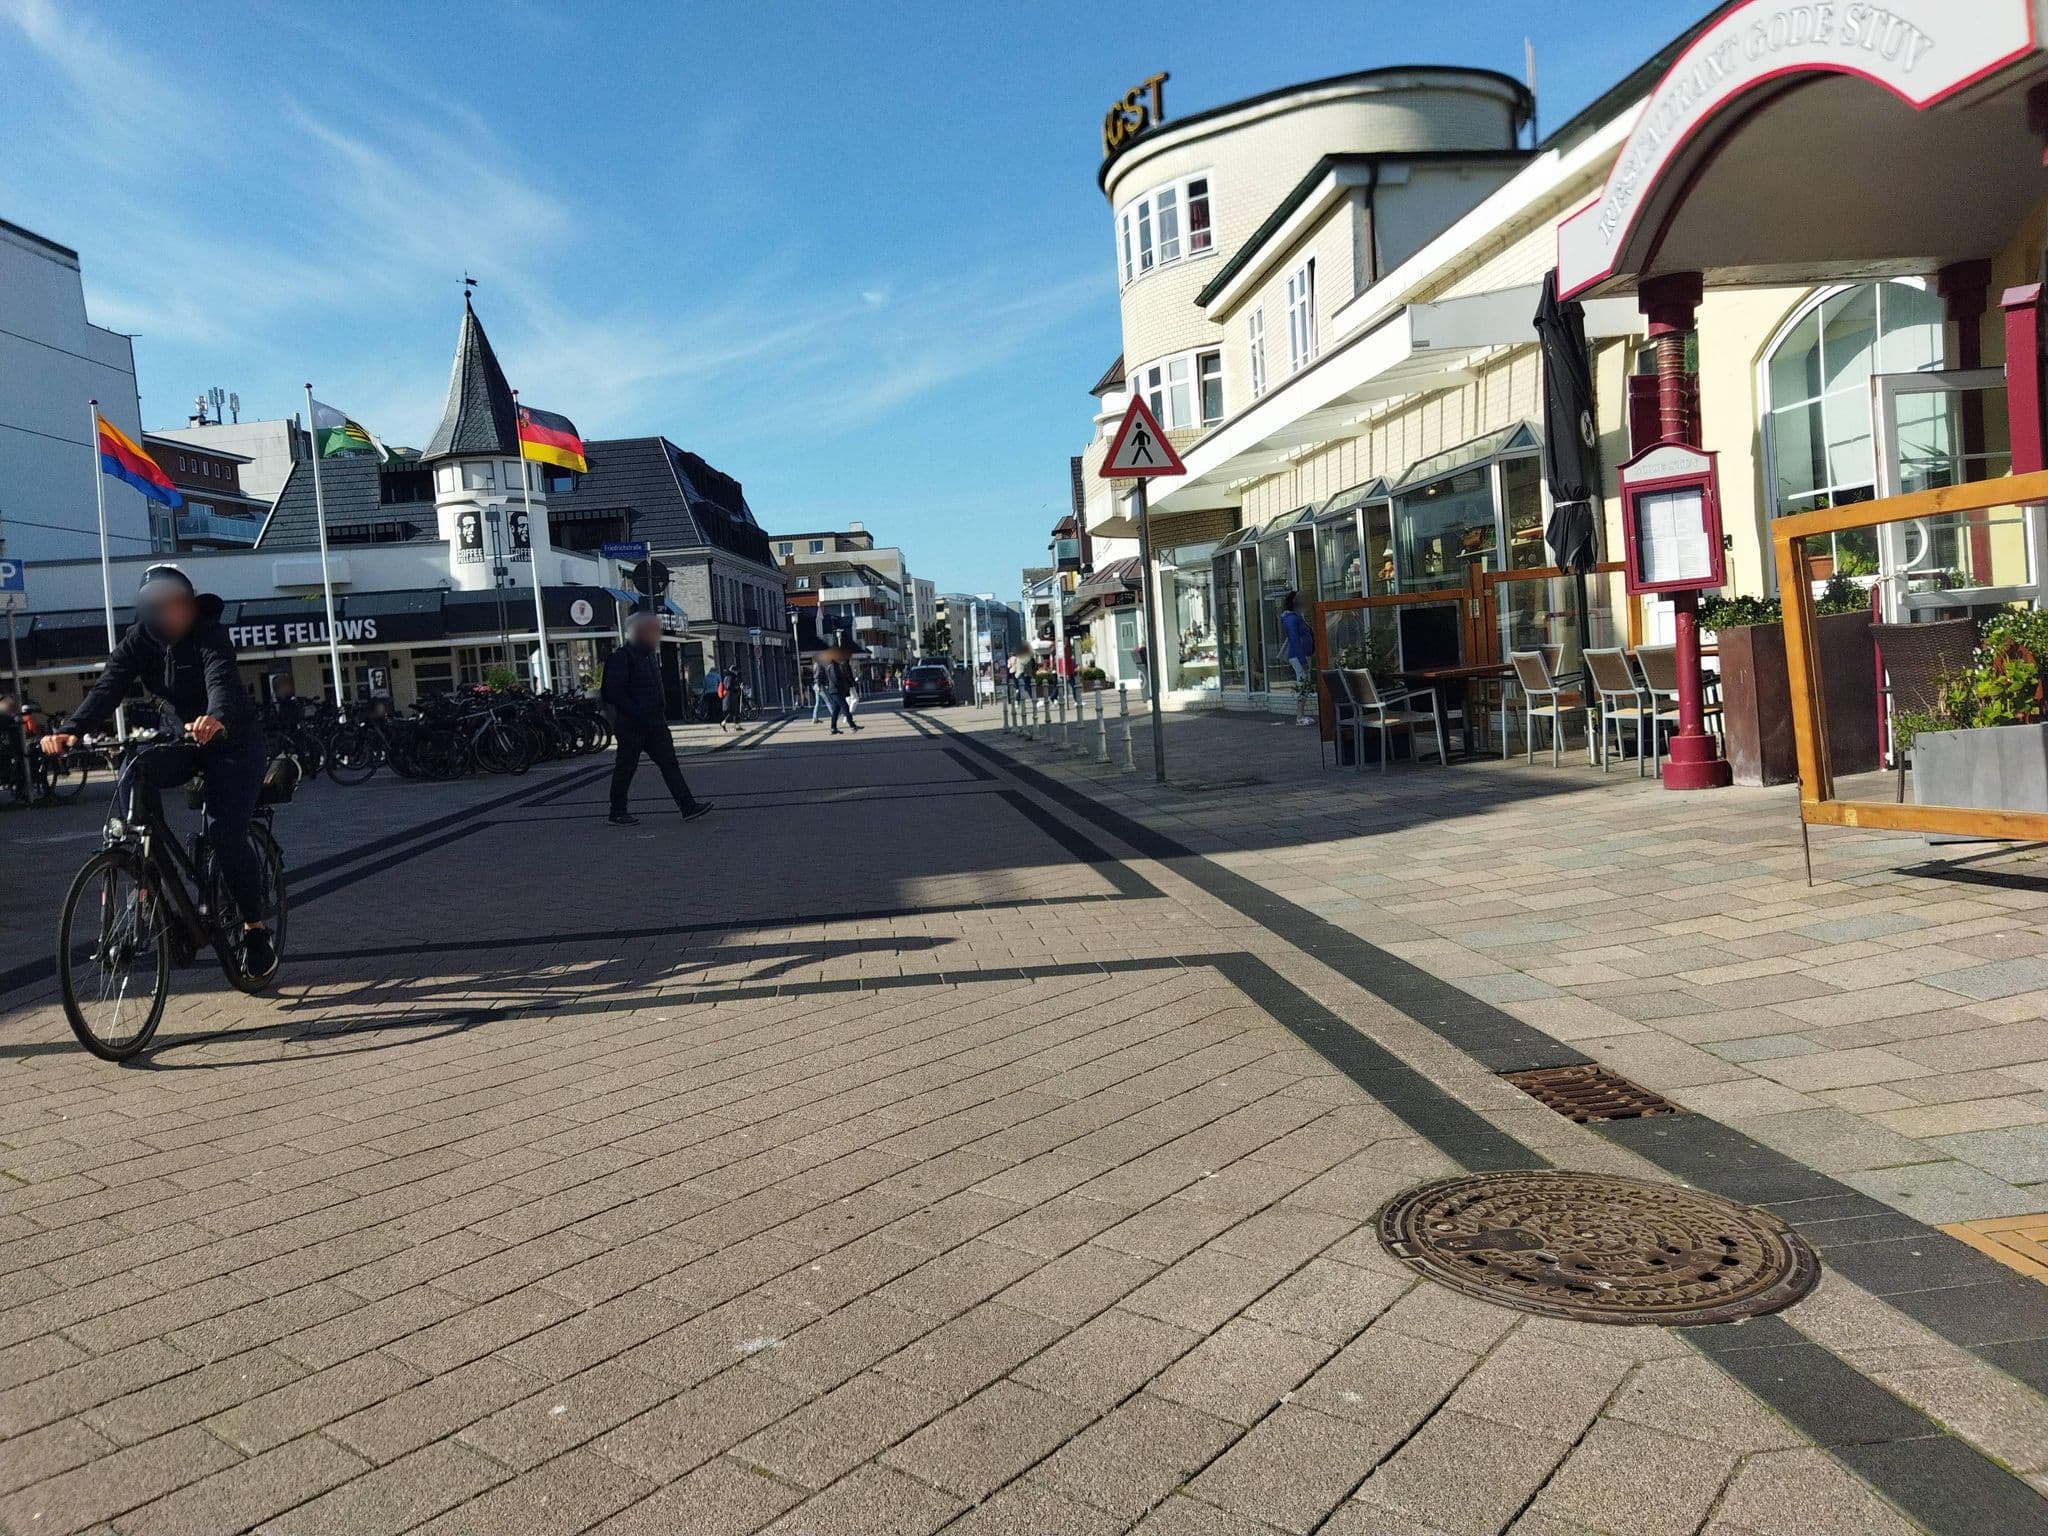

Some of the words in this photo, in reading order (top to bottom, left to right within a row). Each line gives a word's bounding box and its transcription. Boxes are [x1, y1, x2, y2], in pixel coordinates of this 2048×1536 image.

[1744, 1, 1834, 62] GODE
[1839, 2, 1935, 73] STUV
[456, 548, 482, 557] COFFEE
[604, 543, 642, 552] Friedrichstraße
[0, 562, 16, 588] P
[283, 618, 378, 643] FELLOWS
